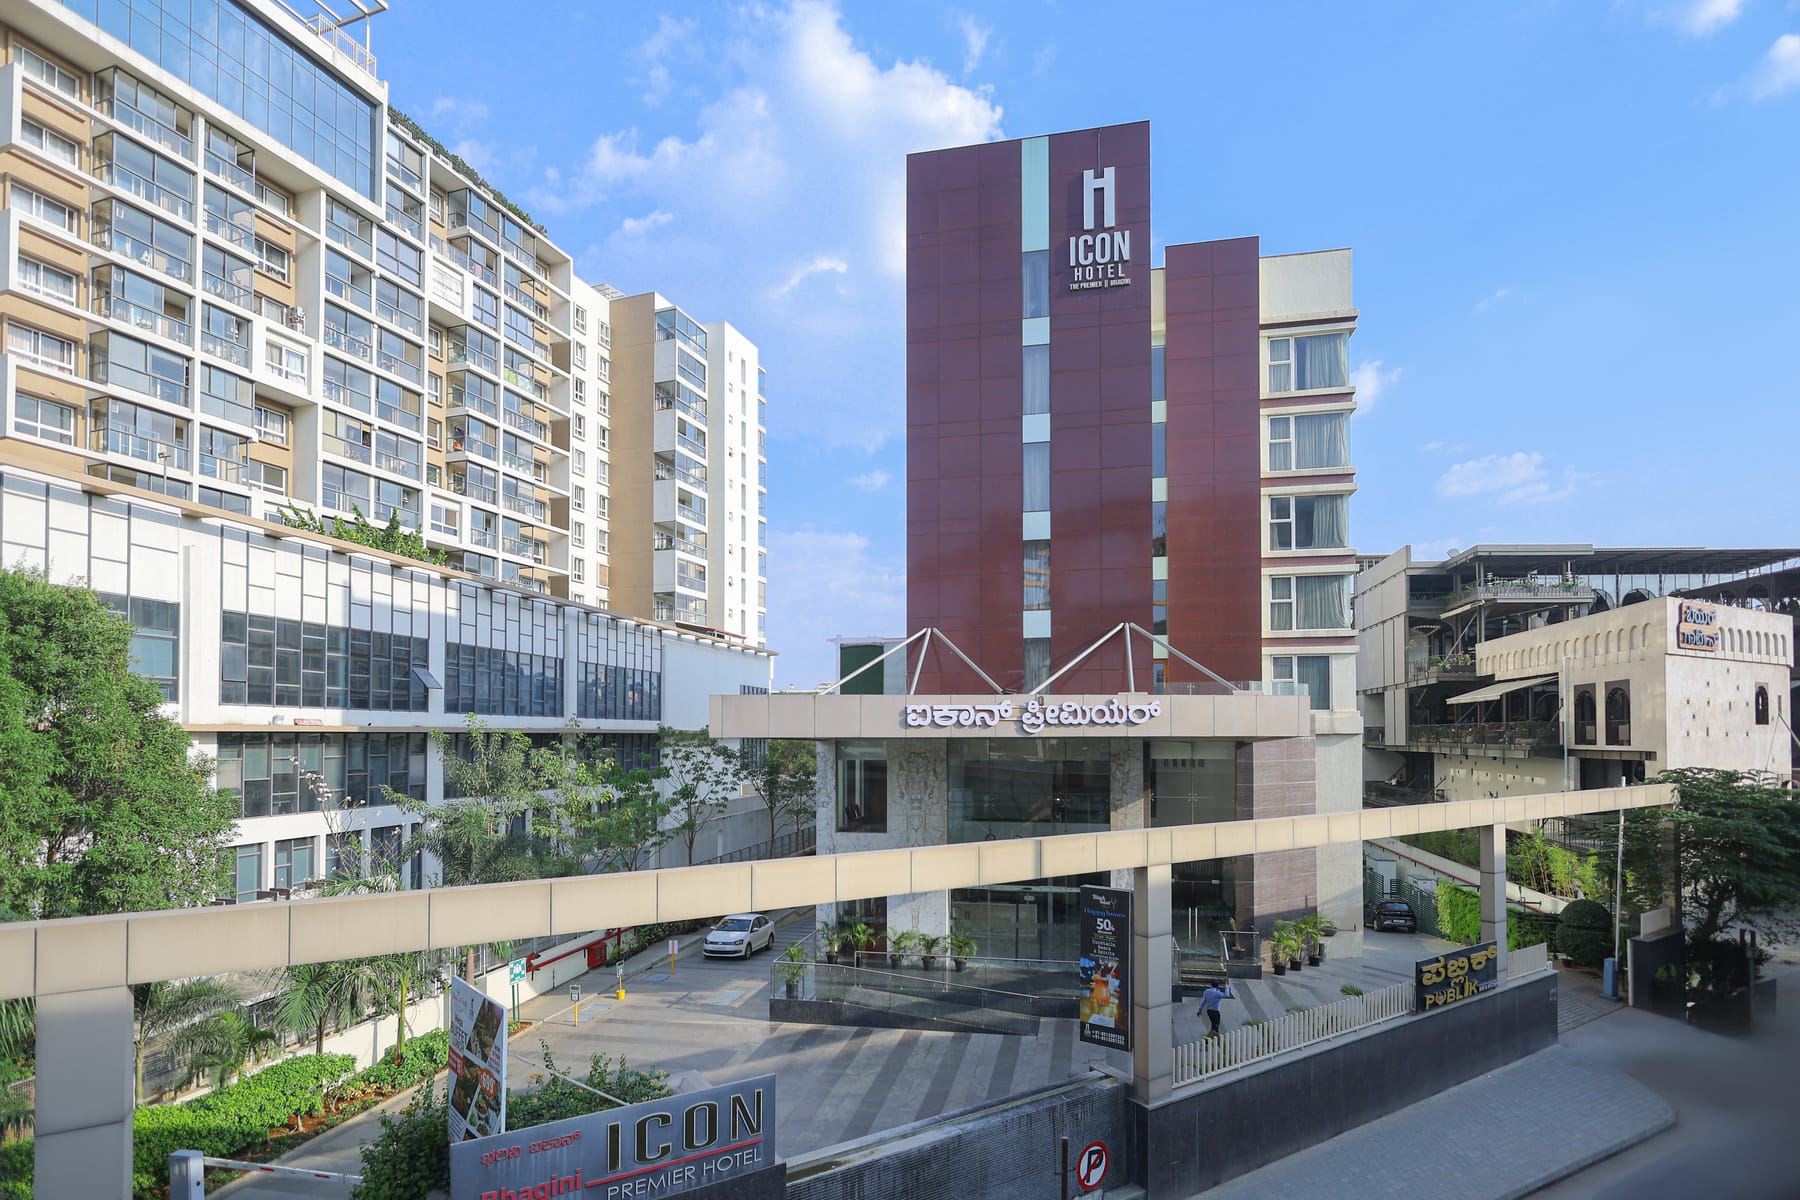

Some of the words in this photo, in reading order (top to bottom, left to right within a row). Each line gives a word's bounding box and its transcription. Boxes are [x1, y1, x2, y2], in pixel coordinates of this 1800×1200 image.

[1069, 230, 1131, 267] ICON
[1074, 263, 1126, 282] HOTEL
[1080, 280, 1103, 289] PREMIER
[906, 699, 1013, 727] ಐಕಾನ್
[607, 1088, 763, 1174] ICON
[607, 1165, 696, 1200] PREMIER
[703, 1148, 762, 1177] HOTEL
